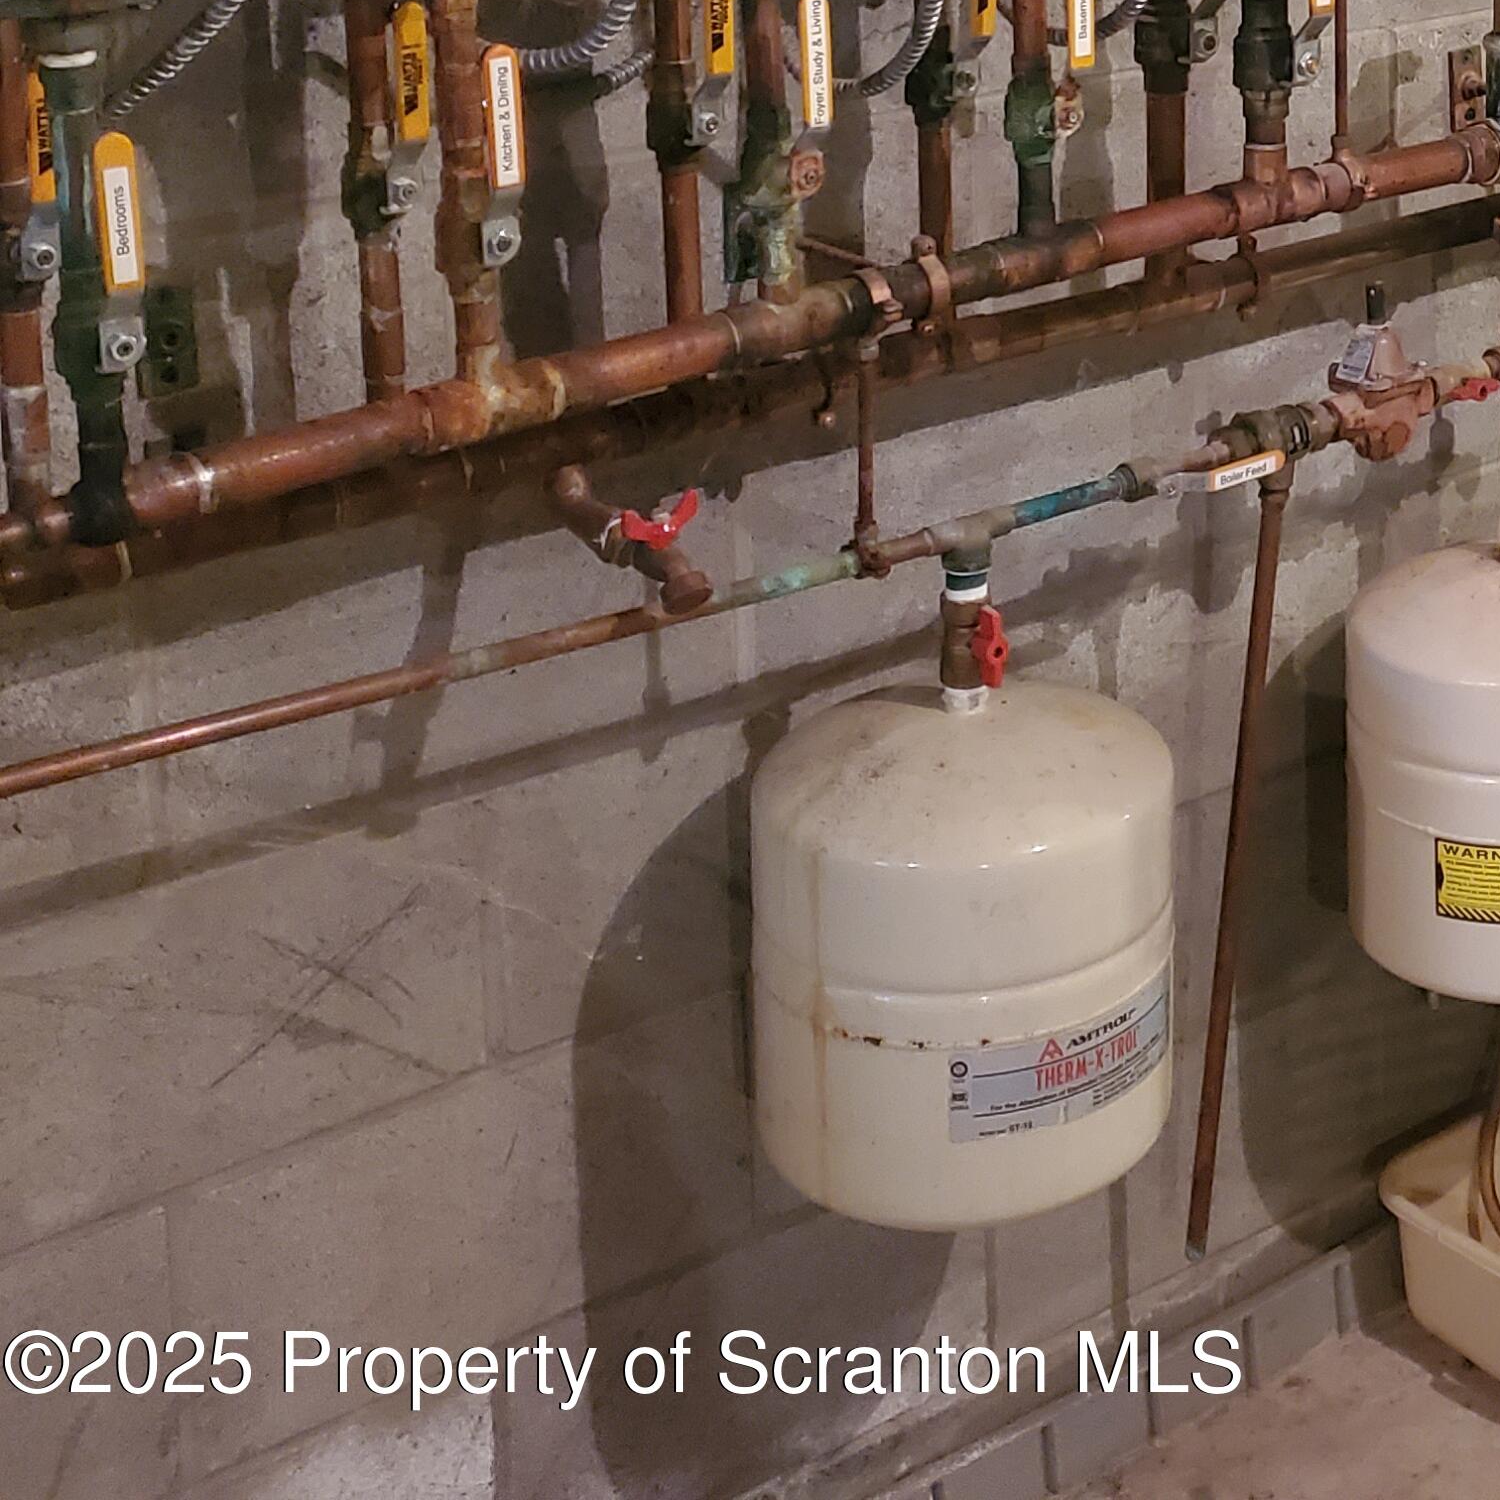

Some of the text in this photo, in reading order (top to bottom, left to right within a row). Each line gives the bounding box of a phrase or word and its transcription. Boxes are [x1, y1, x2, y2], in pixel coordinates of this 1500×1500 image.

[809, 0, 828, 125] Foyer, Study & Living
[496, 66, 513, 172] Kitchen & Dining
[113, 186, 131, 257] Bedrooms
[1220, 461, 1267, 485] Boiler Feed
